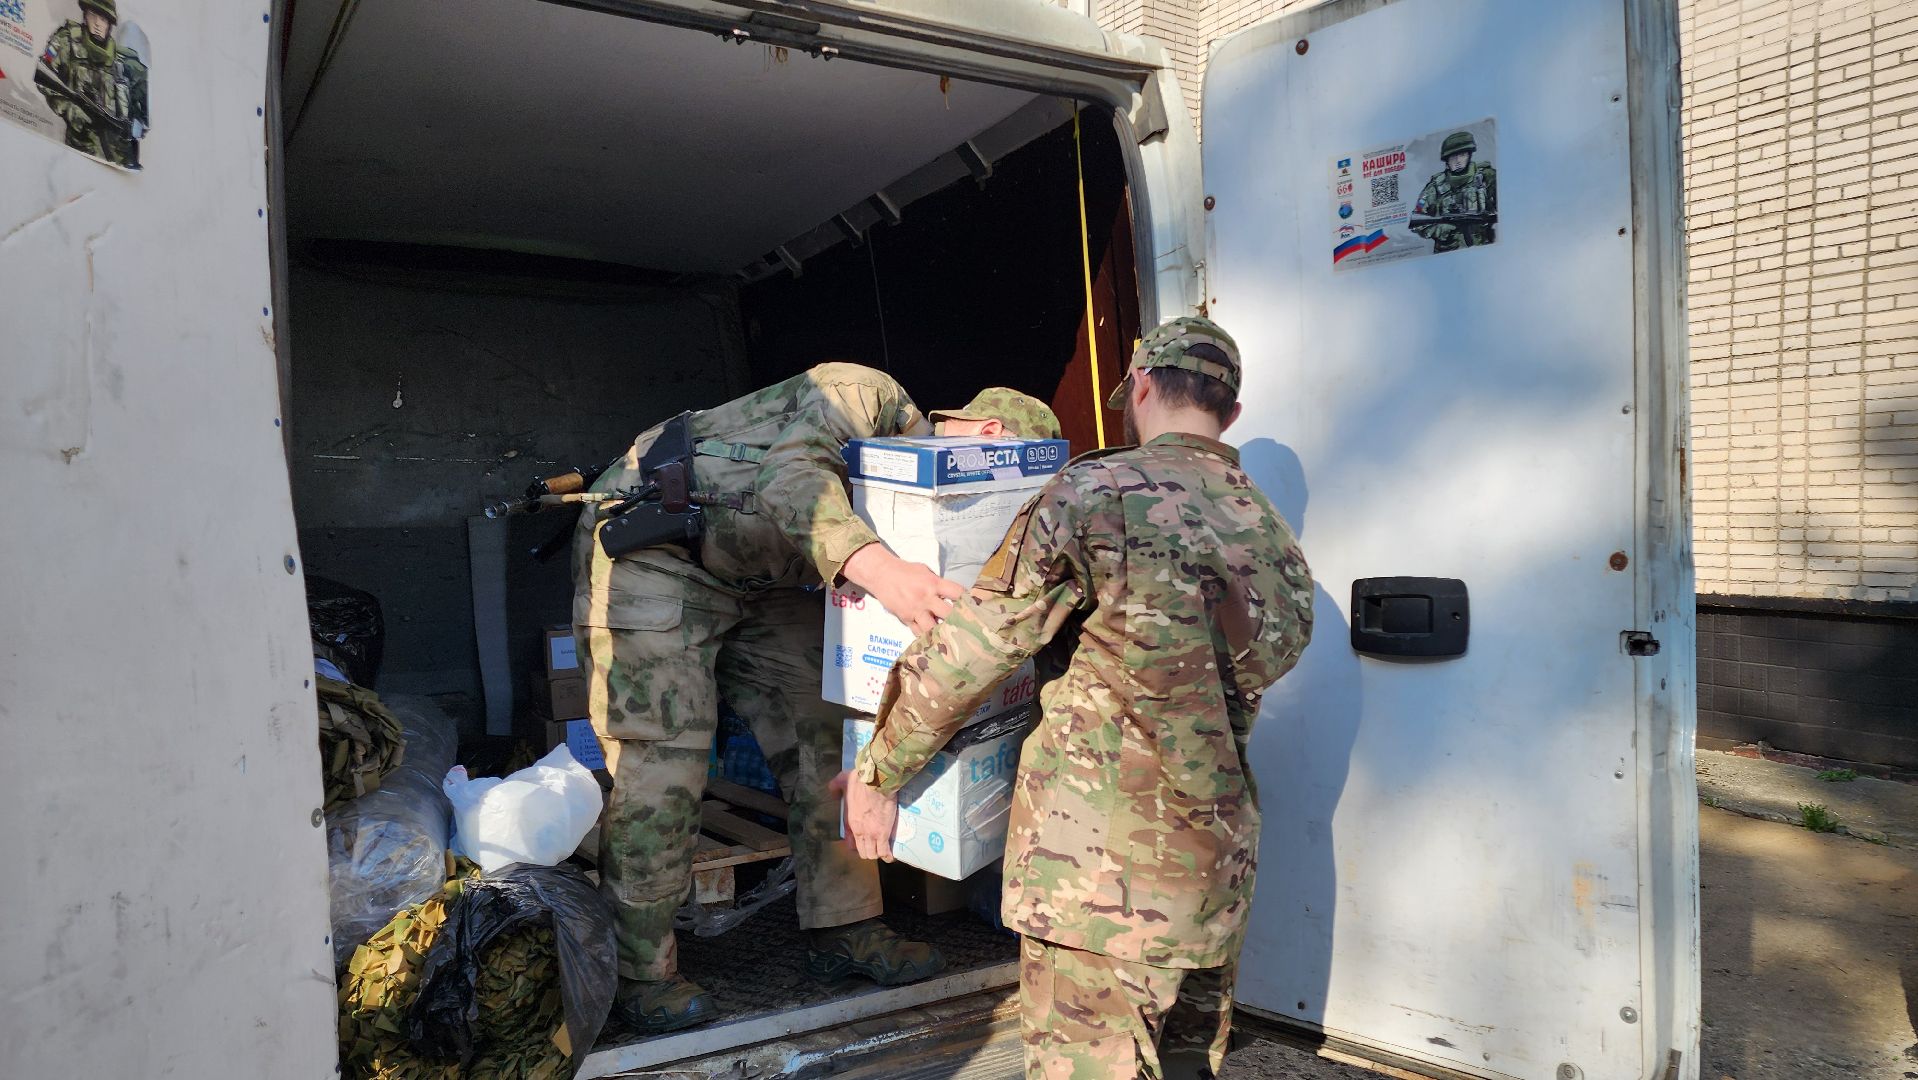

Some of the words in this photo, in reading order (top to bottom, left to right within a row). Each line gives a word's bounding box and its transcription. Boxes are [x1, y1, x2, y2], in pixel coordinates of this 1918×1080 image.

[1363, 151, 1406, 171] КАШИРА
[946, 449, 1020, 470] PROJECTA
[947, 471, 966, 479] CRYSTAL
[967, 469, 981, 477] WHITE
[832, 591, 865, 610] tafo
[869, 634, 903, 648] ВЛАЖНЫЕ
[1003, 676, 1035, 707] tafo
[969, 742, 1018, 784] tafo
